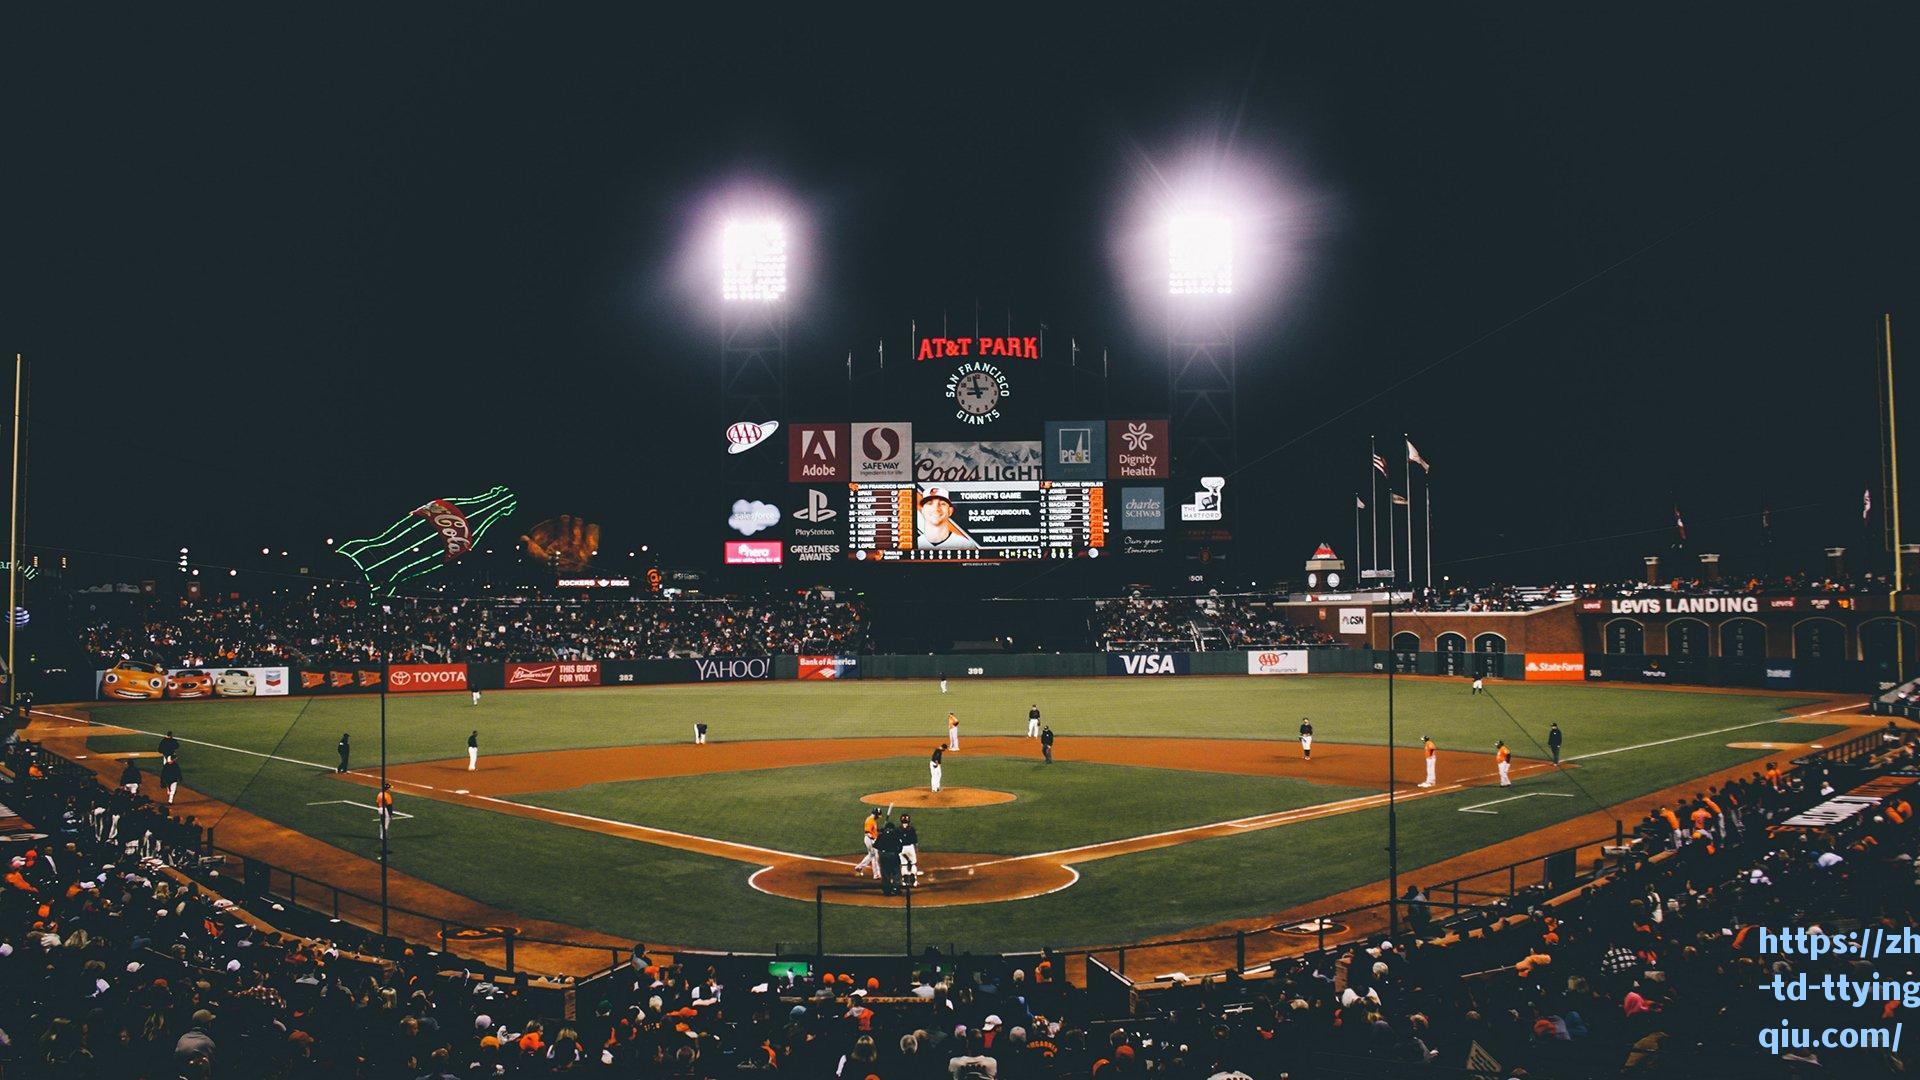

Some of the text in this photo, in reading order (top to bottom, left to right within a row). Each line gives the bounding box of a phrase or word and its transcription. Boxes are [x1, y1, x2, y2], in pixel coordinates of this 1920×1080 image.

[918, 336, 1038, 360] AT&T PARK
[946, 361, 1010, 398] SAN FRANCISCO
[956, 409, 1000, 425] GIANTS
[729, 424, 761, 444] AAA
[1061, 450, 1090, 463] PG&E
[1119, 454, 1157, 466] Dignity
[802, 464, 836, 476] Adobe
[916, 458, 982, 481] Coors
[1121, 466, 1156, 476] Health
[1125, 498, 1160, 509] charles
[795, 528, 835, 538] PlayStation
[790, 545, 840, 553] GREATNESS
[799, 552, 832, 561] AWAITS
[1666, 597, 1758, 613] LANDING
[1350, 616, 1364, 625] CSN
[560, 665, 575, 673] THIS
[695, 658, 770, 681] YAHOO!
[1119, 655, 1176, 674] VISA
[413, 671, 466, 682] TOYOTA
[515, 670, 551, 680] Budweiser
[560, 673, 590, 682] FOR YOU.
